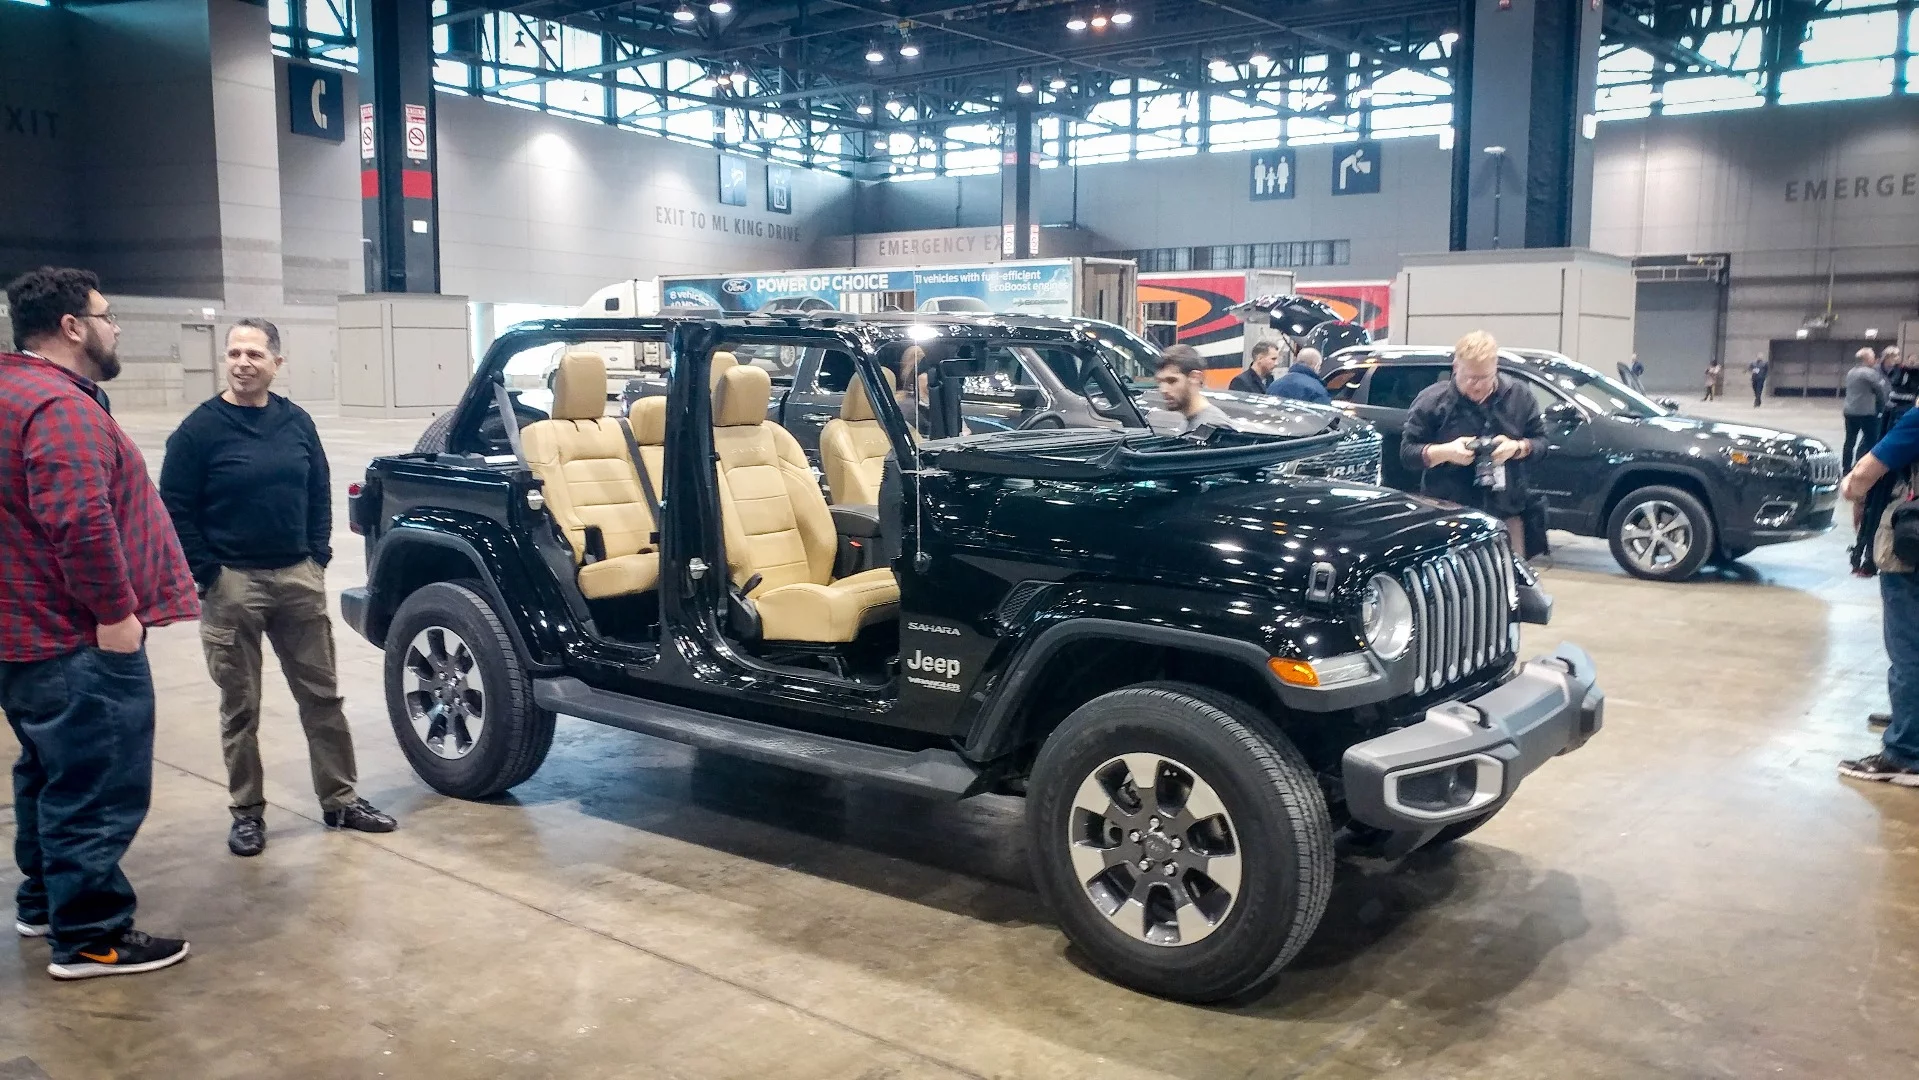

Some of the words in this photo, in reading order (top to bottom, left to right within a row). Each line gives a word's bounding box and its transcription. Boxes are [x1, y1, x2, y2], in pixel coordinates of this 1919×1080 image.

[1785, 172, 1917, 201] EMERGE
[655, 205, 685, 227] EXIT
[690, 210, 706, 229] TO
[712, 214, 729, 233] ML
[734, 217, 762, 237] KING
[768, 222, 800, 242] DRIVE
[878, 235, 976, 257] EMERGENCY
[756, 276, 808, 293] POWER
[809, 275, 831, 291] OF
[831, 273, 889, 291] CHOICE
[923, 271, 959, 284] vehicles
[959, 271, 980, 283] with
[981, 269, 1042, 283] fuel-efficient
[988, 281, 1032, 293] EcoBoost
[907, 621, 962, 636] SAHARA
[906, 649, 961, 679] Jeep
